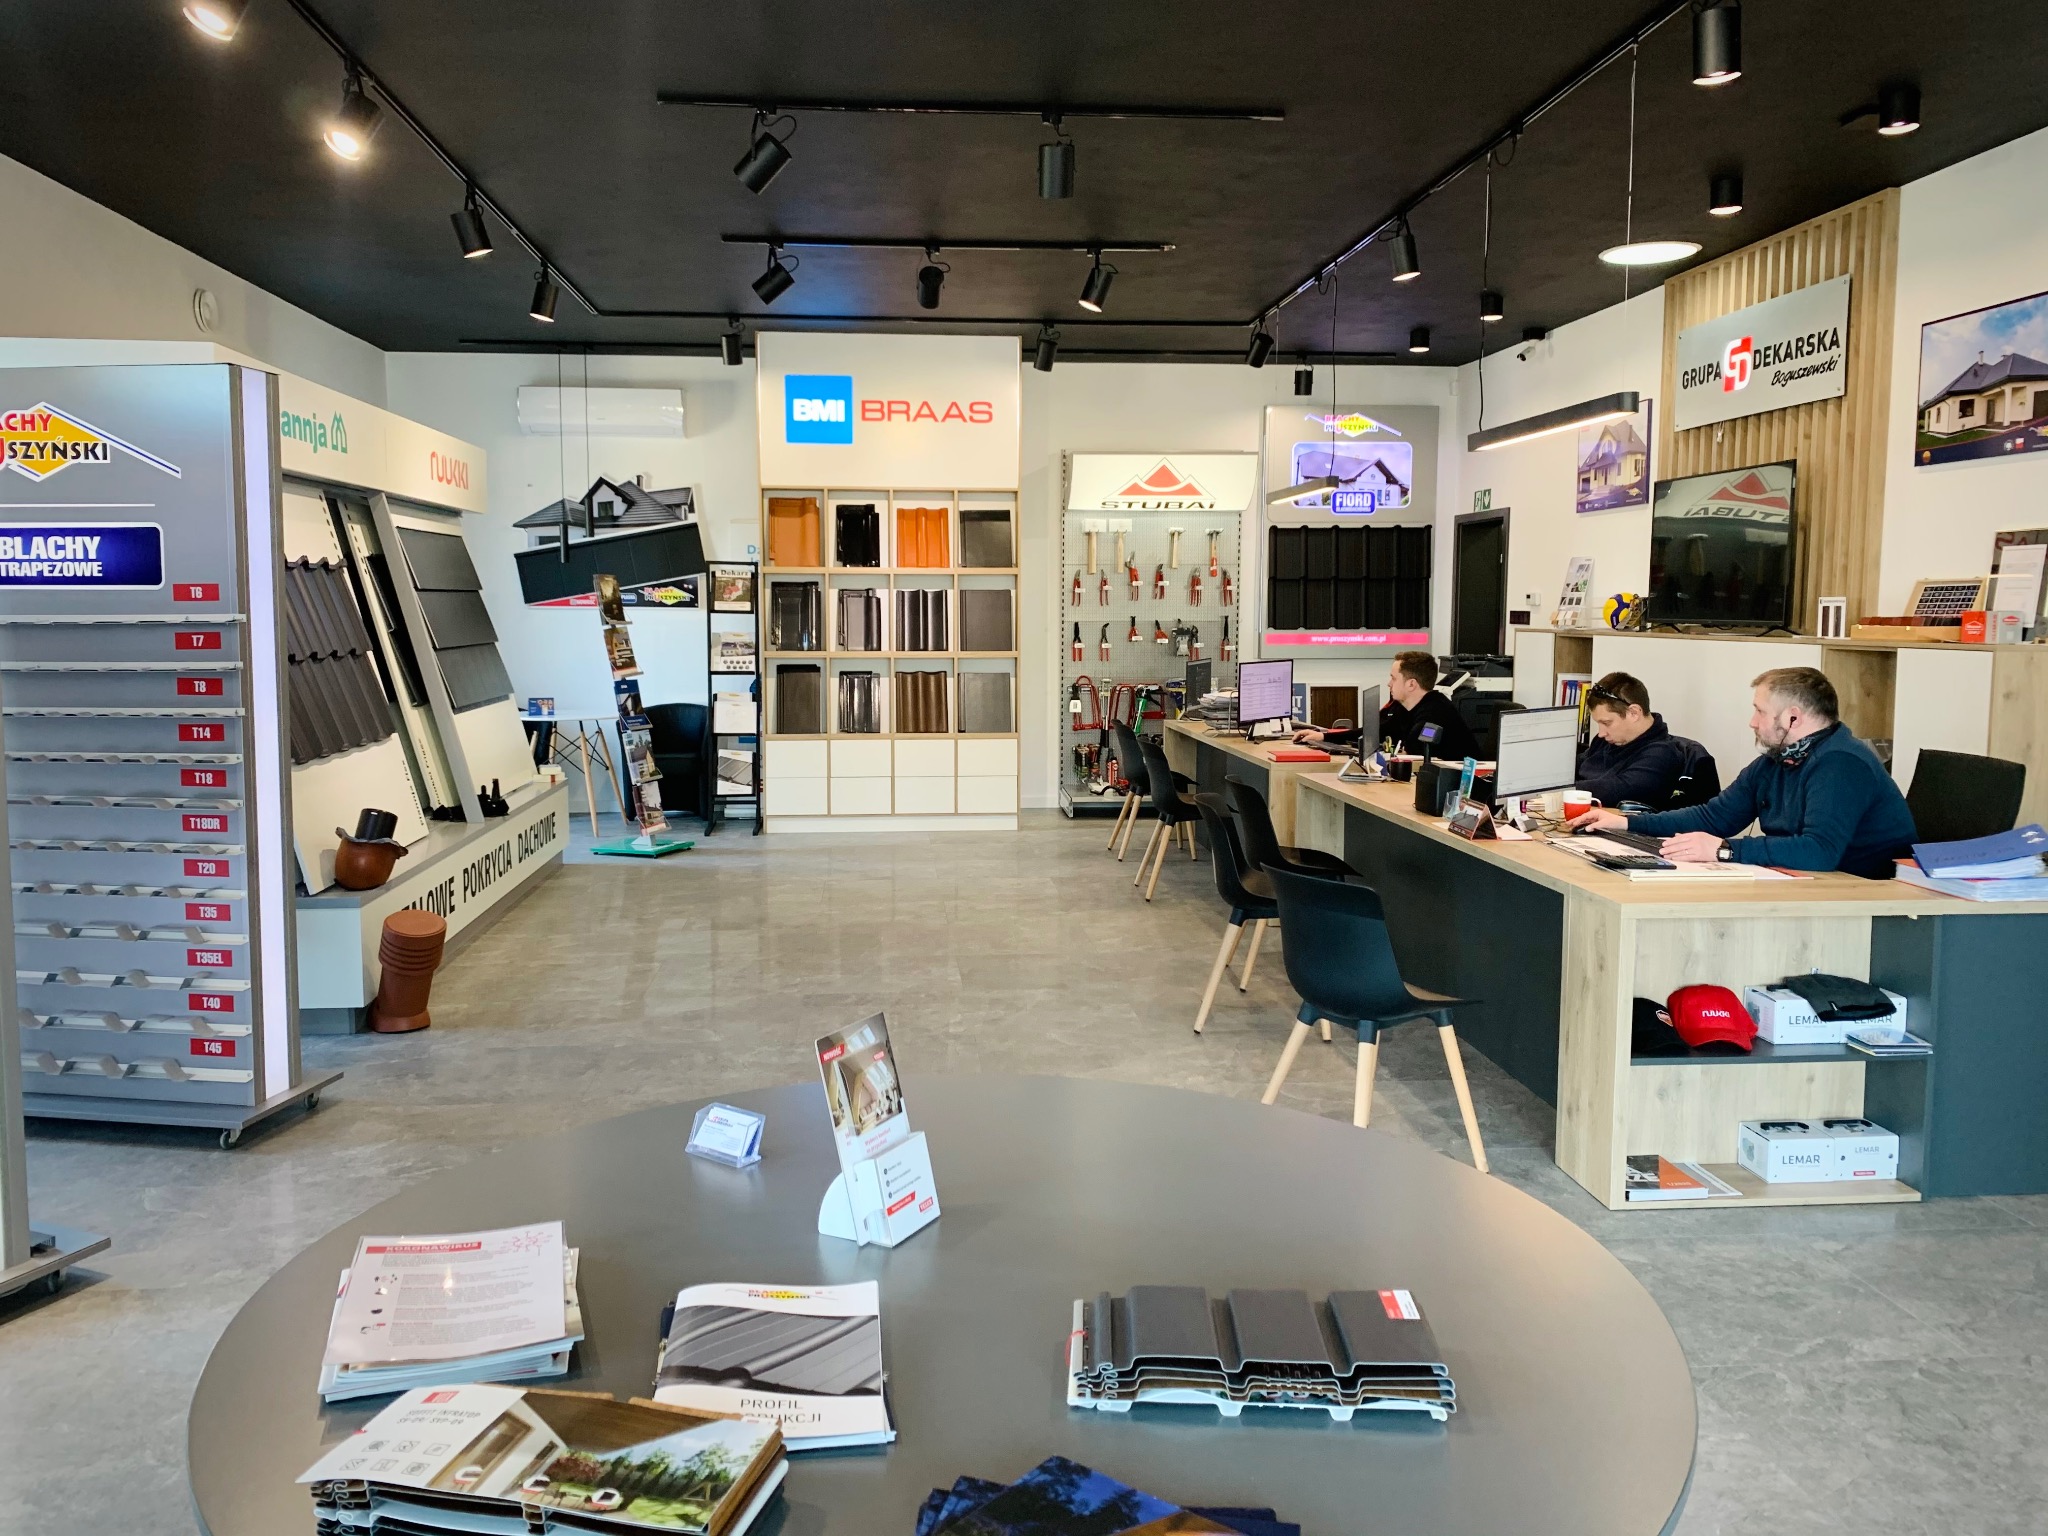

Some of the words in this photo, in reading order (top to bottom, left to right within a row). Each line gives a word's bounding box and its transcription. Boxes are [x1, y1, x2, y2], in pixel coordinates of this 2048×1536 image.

[1682, 361, 1722, 390] GRUPA
[1752, 327, 1841, 371] DEKARSKA
[1771, 353, 1842, 388] Boguszewski
[793, 398, 846, 423] BMI
[861, 399, 993, 424] BRAAS
[430, 451, 469, 490] ruukki
[1101, 501, 1216, 509] STUBAI
[1335, 492, 1372, 507] FIORD
[0, 535, 101, 560] BLACHY
[0, 562, 103, 577] TRAPEZOWE
[189, 586, 203, 599] T6
[191, 635, 205, 647] T7
[193, 680, 207, 693] T8
[192, 727, 211, 739] T14
[194, 772, 213, 785] T18
[189, 817, 221, 830] T18DR
[463, 839, 513, 903] POKRYCIA
[517, 811, 556, 864] DACHOWE
[197, 862, 216, 875] T20
[199, 906, 218, 919] T35
[195, 951, 224, 965] T35EL
[202, 997, 221, 1009] T40
[1702, 1009, 1730, 1018] ruukki
[203, 1042, 222, 1054] T45
[1855, 1146, 1880, 1154] LEMAR
[1782, 1154, 1821, 1165] LEMAR
[386, 1241, 479, 1252] KORONAWIRUS
[740, 1398, 804, 1409] PROFIL
